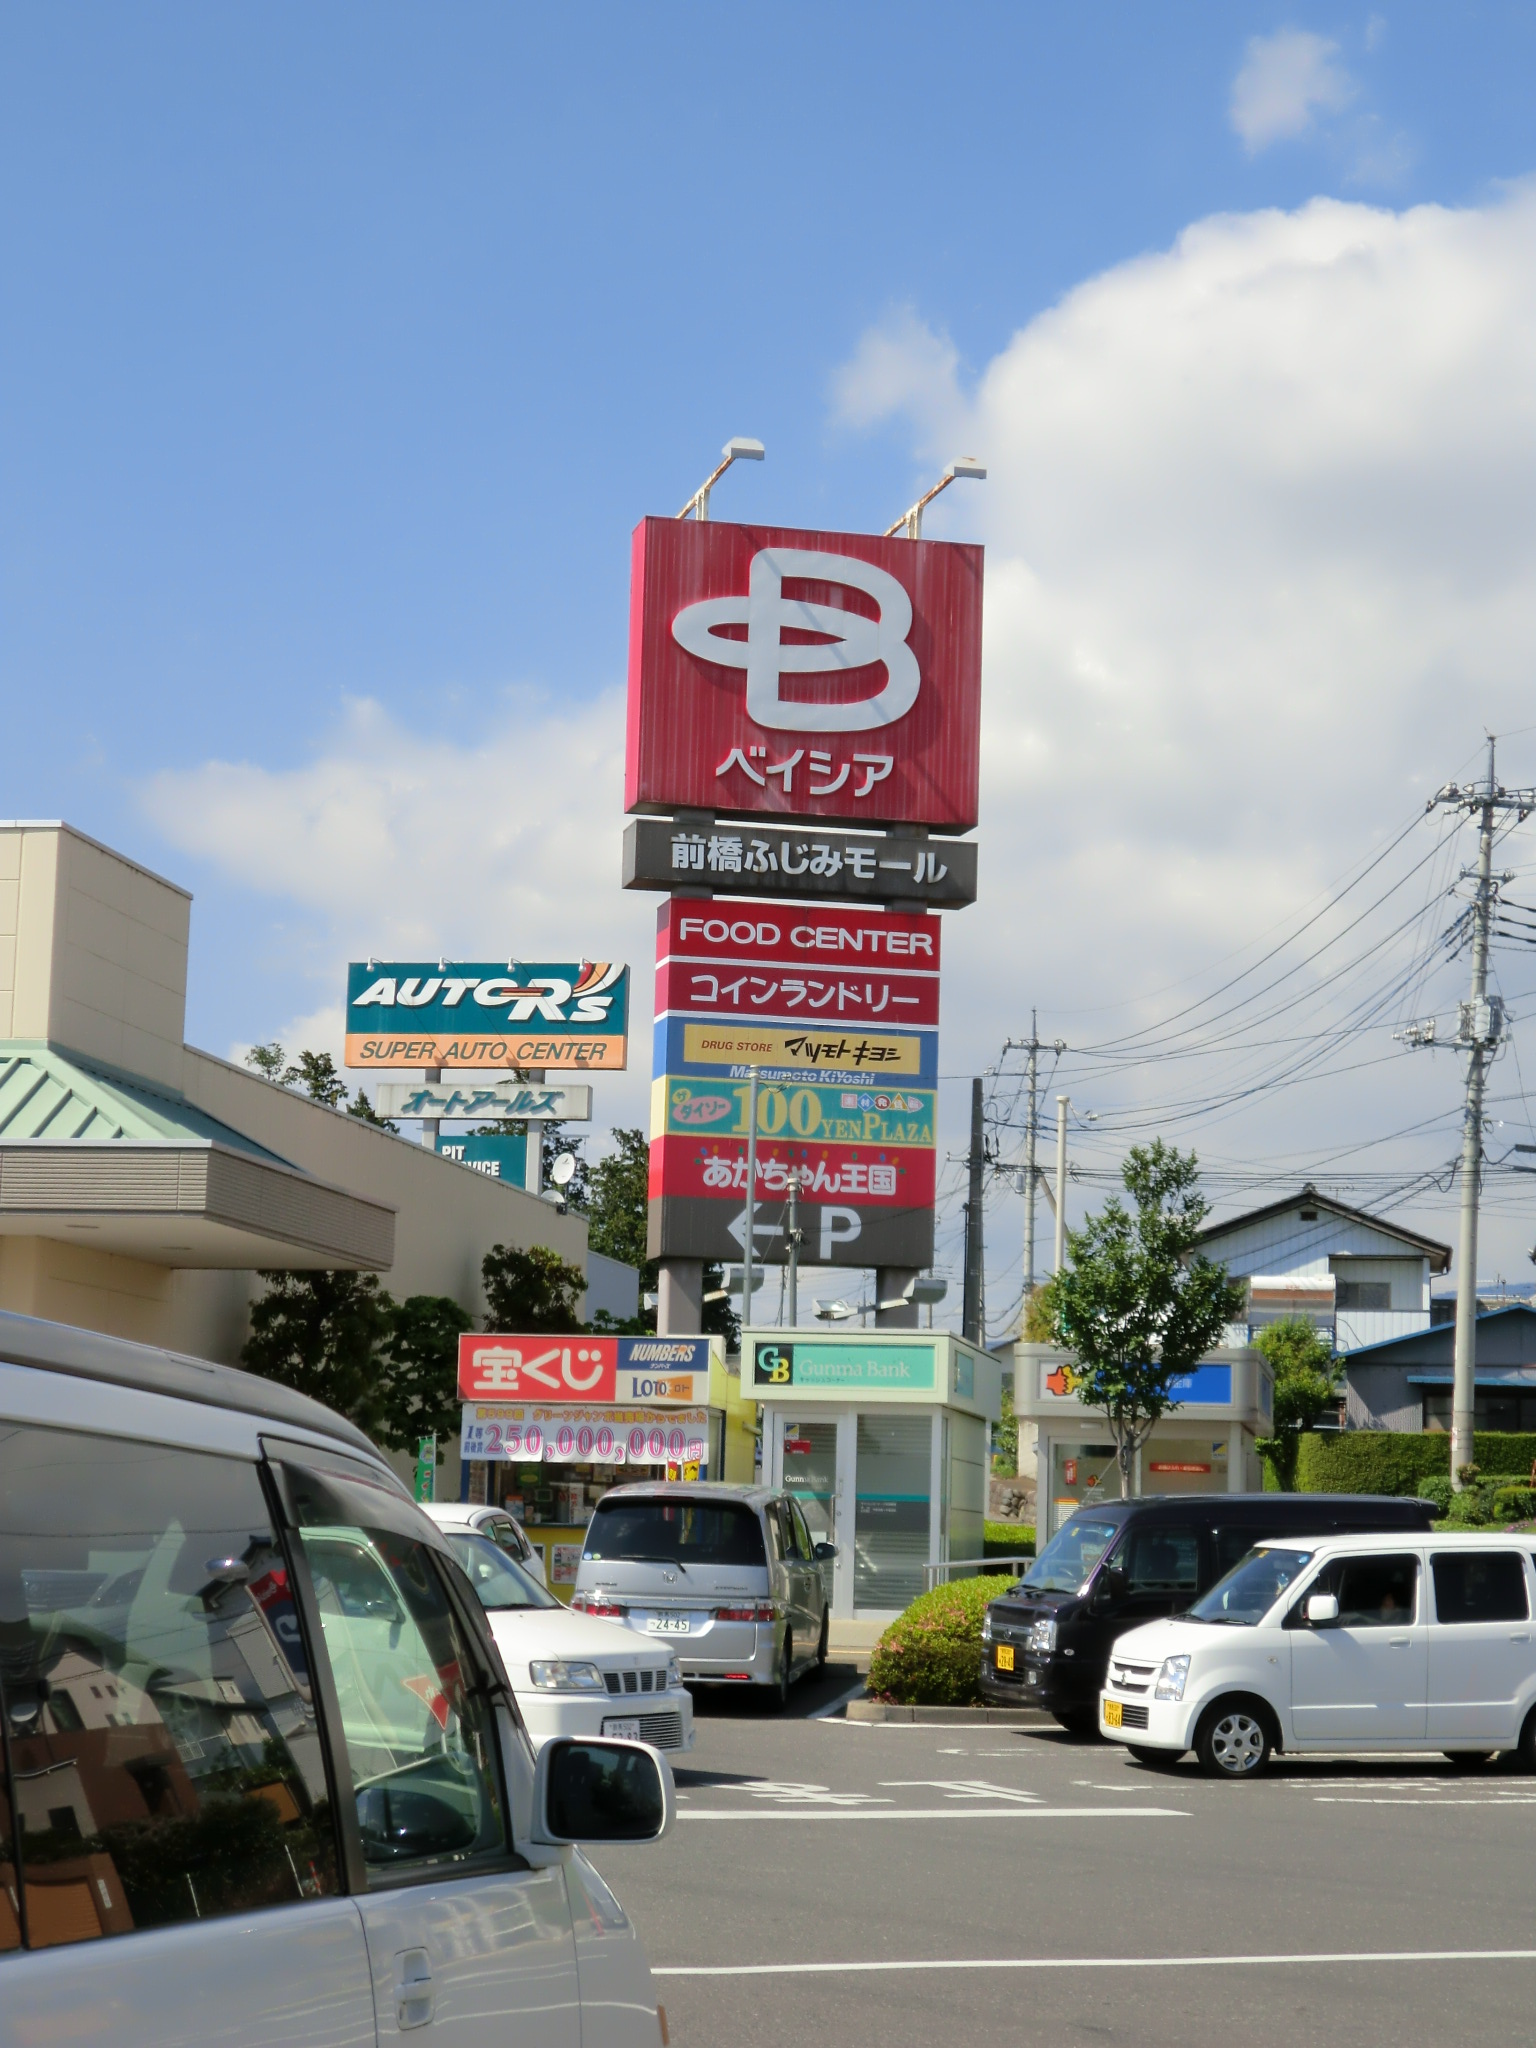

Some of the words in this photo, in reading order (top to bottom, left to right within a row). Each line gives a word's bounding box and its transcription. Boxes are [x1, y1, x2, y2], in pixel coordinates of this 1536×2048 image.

[715, 746, 894, 797] ベイシア
[671, 833, 947, 884] 前橋ふじみモール
[680, 918, 780, 945] FOOD
[790, 926, 933, 956] CENTER
[690, 975, 919, 1012] コインランドリー
[360, 1041, 436, 1059] SUPER
[442, 1042, 507, 1060] AUTO
[516, 1042, 607, 1061] CENTER
[701, 1040, 733, 1050] DRUG
[736, 1041, 772, 1052] STORE
[785, 1036, 901, 1066] マツモトキヨシ
[730, 1066, 817, 1083] Masumoto
[820, 1070, 875, 1085] KiYoshi
[401, 1089, 564, 1114] オートアールズ
[680, 1100, 726, 1120] ダイソー
[732, 1086, 822, 1136] 100
[822, 1121, 862, 1140] YEN
[442, 1146, 465, 1161] PIT
[702, 1156, 897, 1196] あかちゃん王国
[819, 1206, 862, 1260] P
[629, 1343, 696, 1362] NUMBERS
[472, 1346, 603, 1391] 宝くじ
[799, 1359, 862, 1377] Gunma
[867, 1360, 911, 1378] Bank
[632, 1377, 667, 1398] LOTO
[674, 1384, 690, 1393] ロト
[656, 1618, 687, 1631] 24-45
